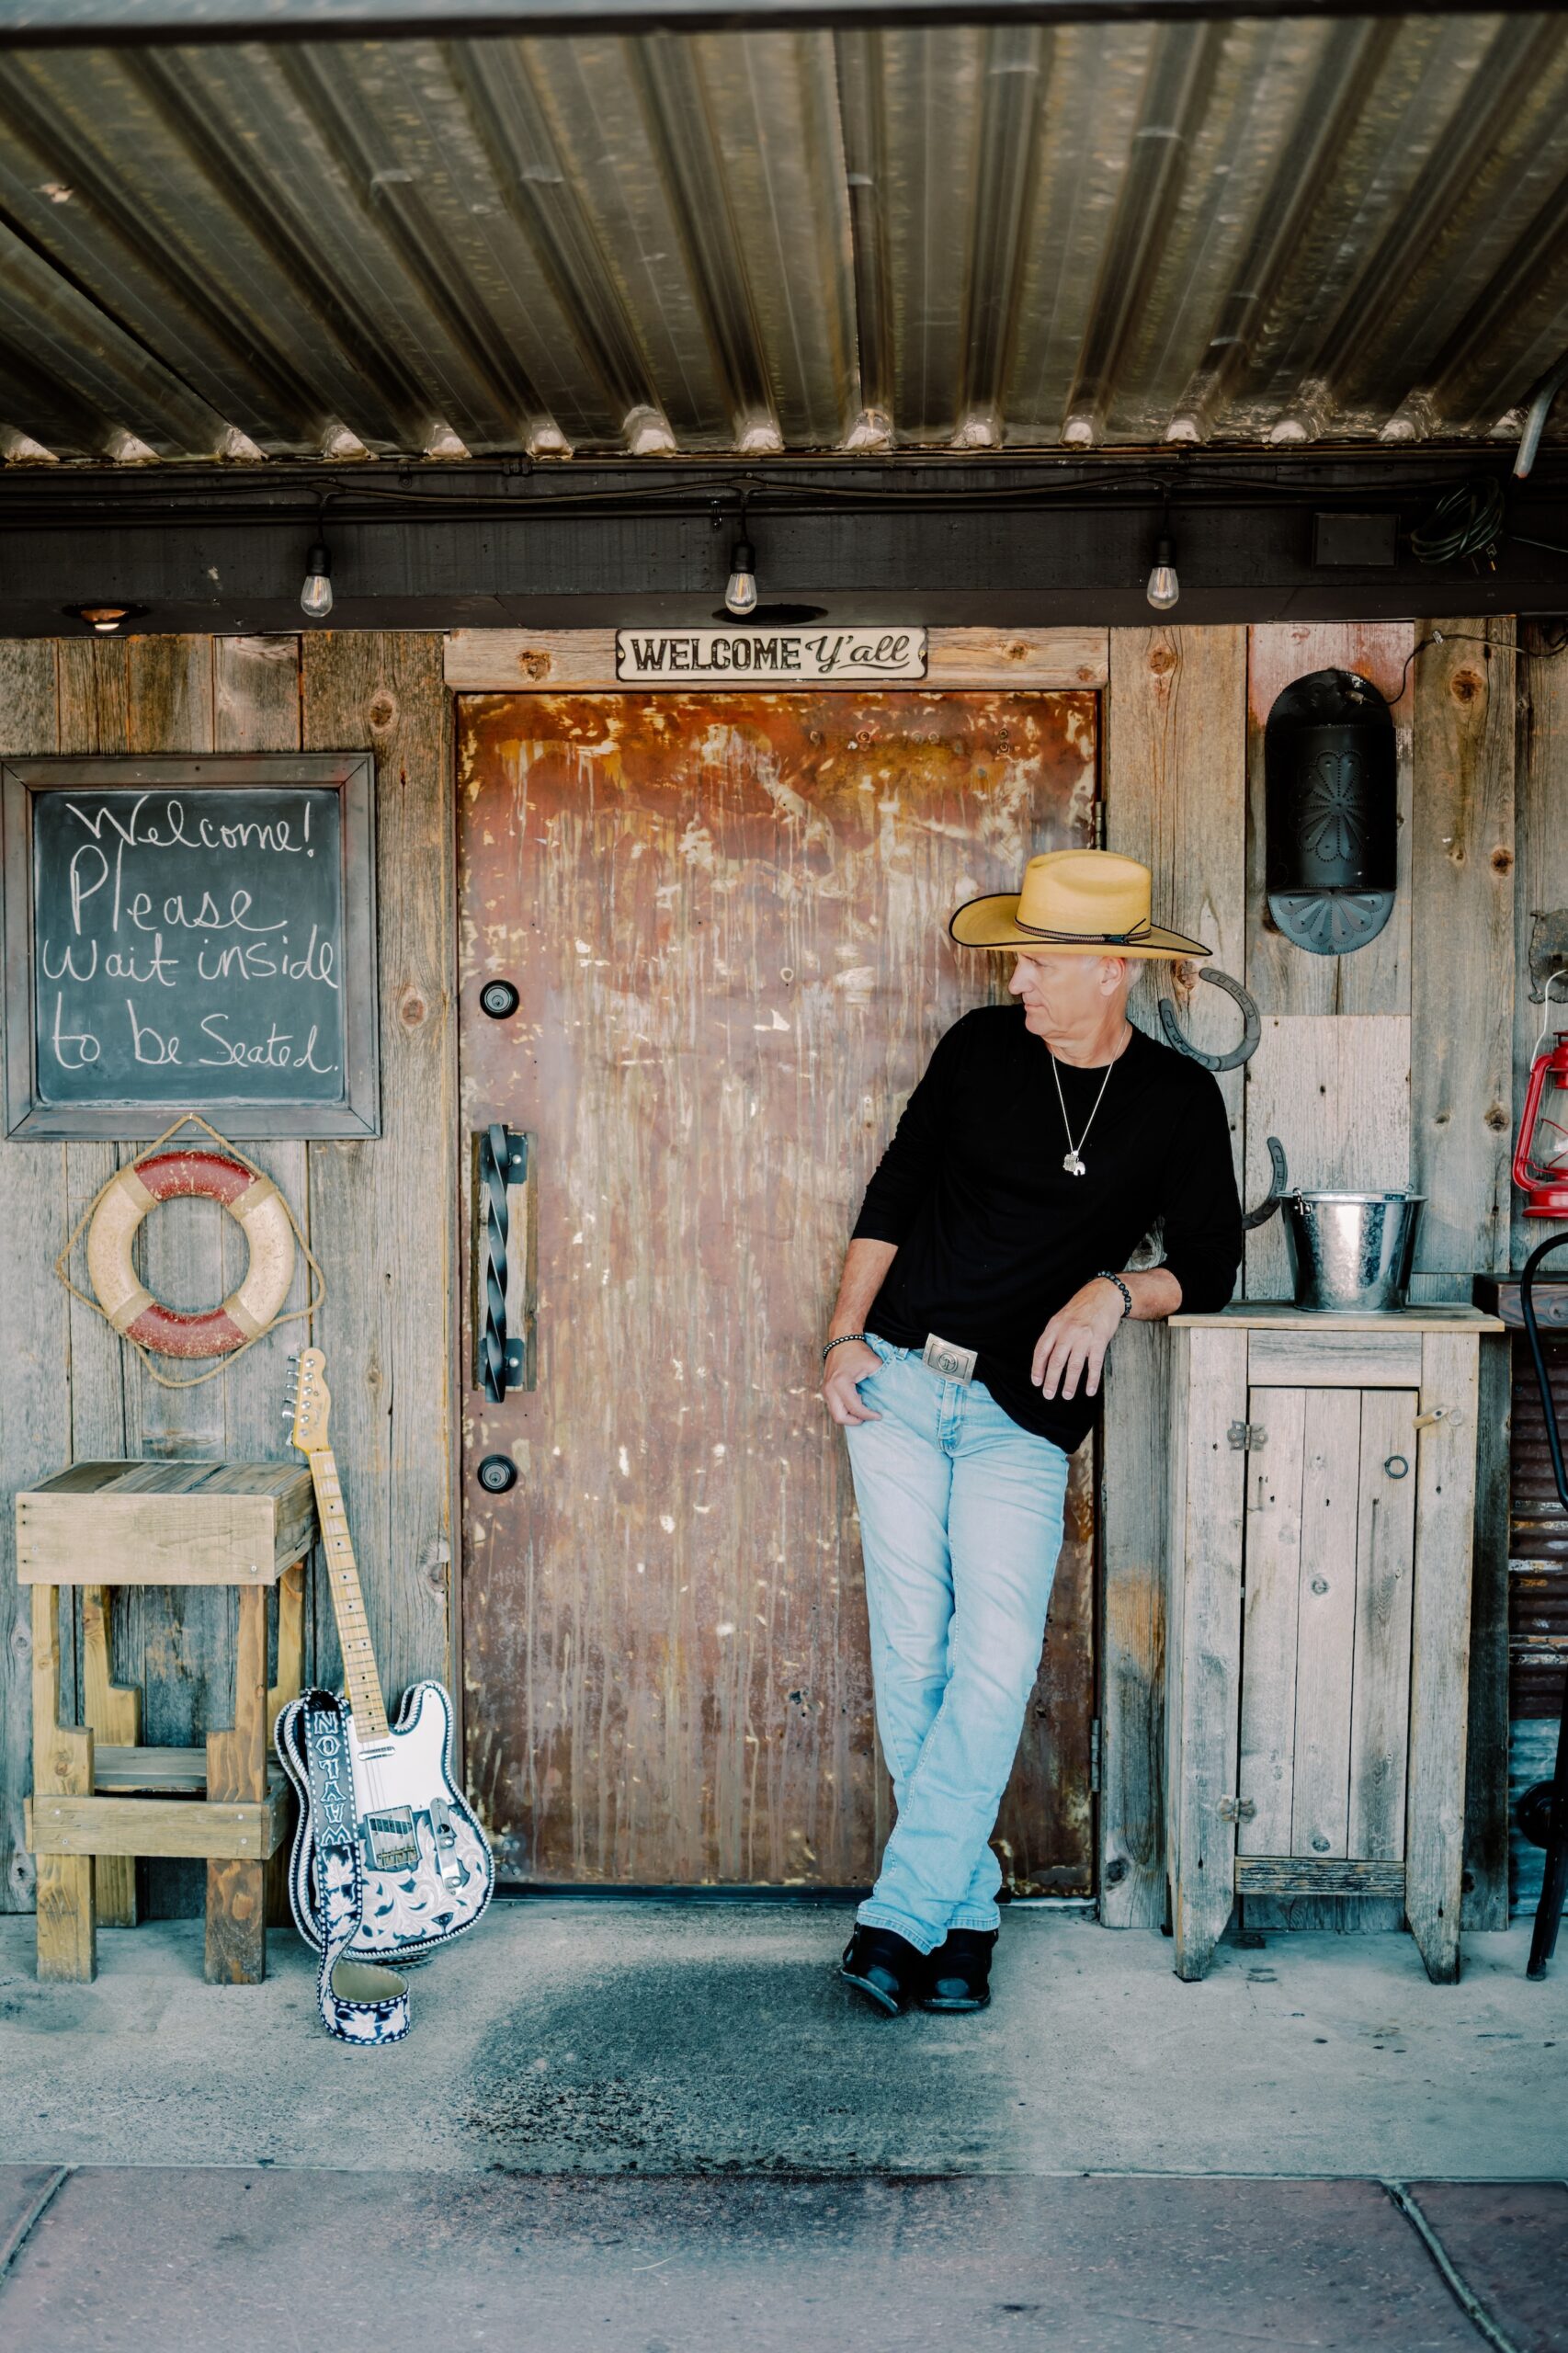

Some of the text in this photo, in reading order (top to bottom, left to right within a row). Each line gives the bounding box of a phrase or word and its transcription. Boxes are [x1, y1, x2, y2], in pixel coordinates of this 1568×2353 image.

[629, 634, 911, 675] WELCOME Y'all
[65, 794, 315, 858] Welcome!
[69, 837, 289, 936] Please
[52, 991, 101, 1070] to
[127, 999, 183, 1066] be
[313, 1711, 353, 1847] WAYLON
